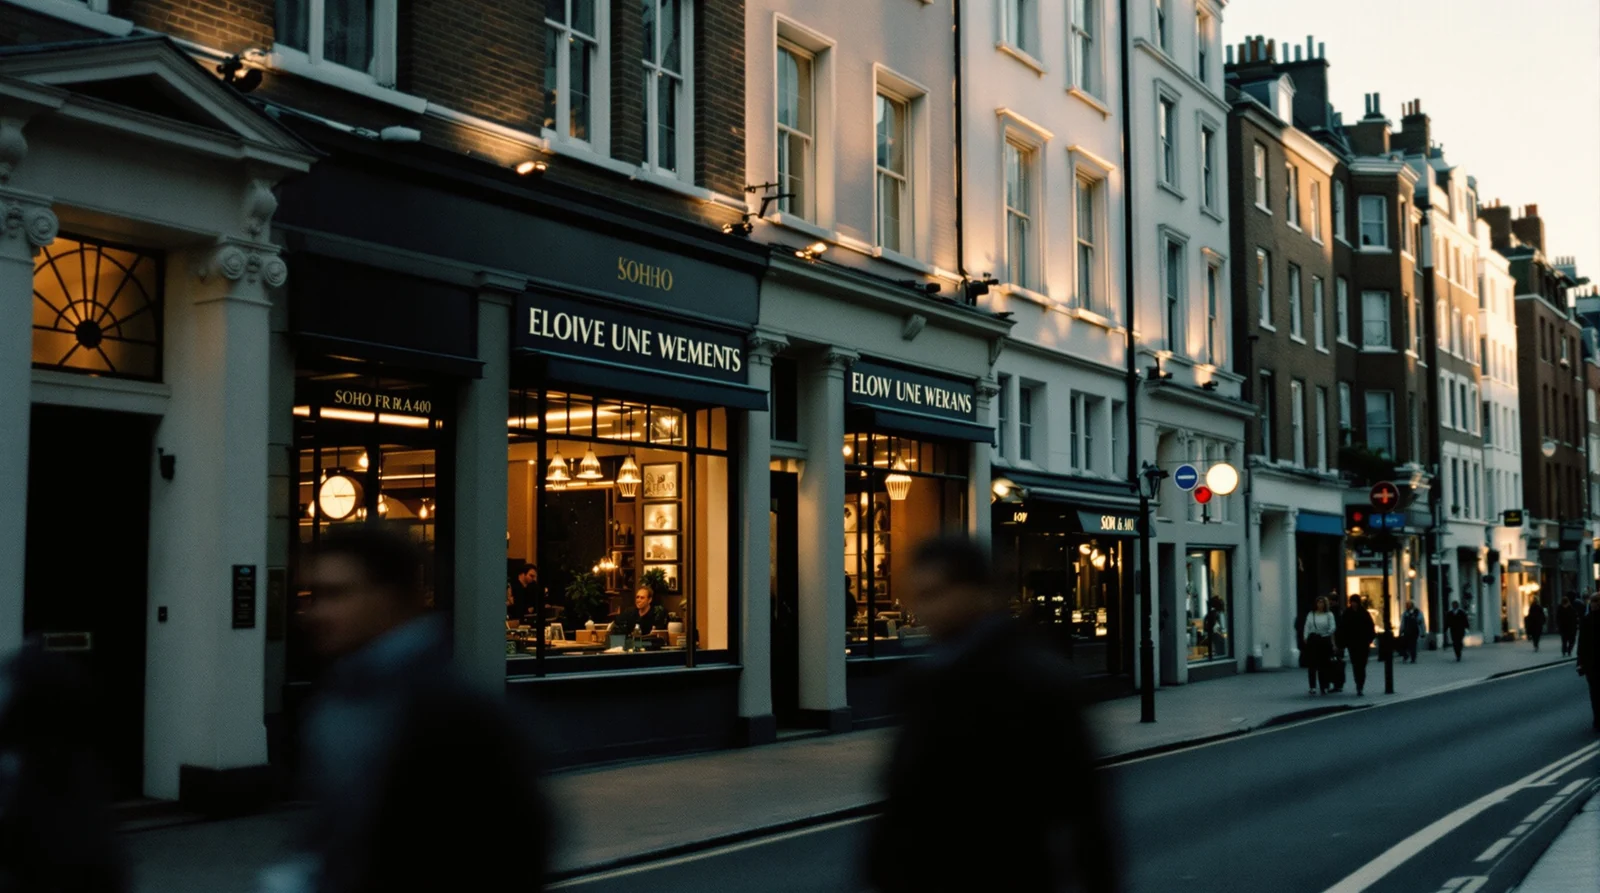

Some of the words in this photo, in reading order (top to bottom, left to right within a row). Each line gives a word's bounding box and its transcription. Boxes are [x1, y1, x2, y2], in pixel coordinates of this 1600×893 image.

[529, 307, 605, 347] ELOIVE
[612, 323, 652, 356] UNE
[658, 332, 741, 372] WEMENTS
[335, 389, 372, 407] SOHO
[852, 372, 892, 398] ELOW
[896, 380, 922, 404] UNE
